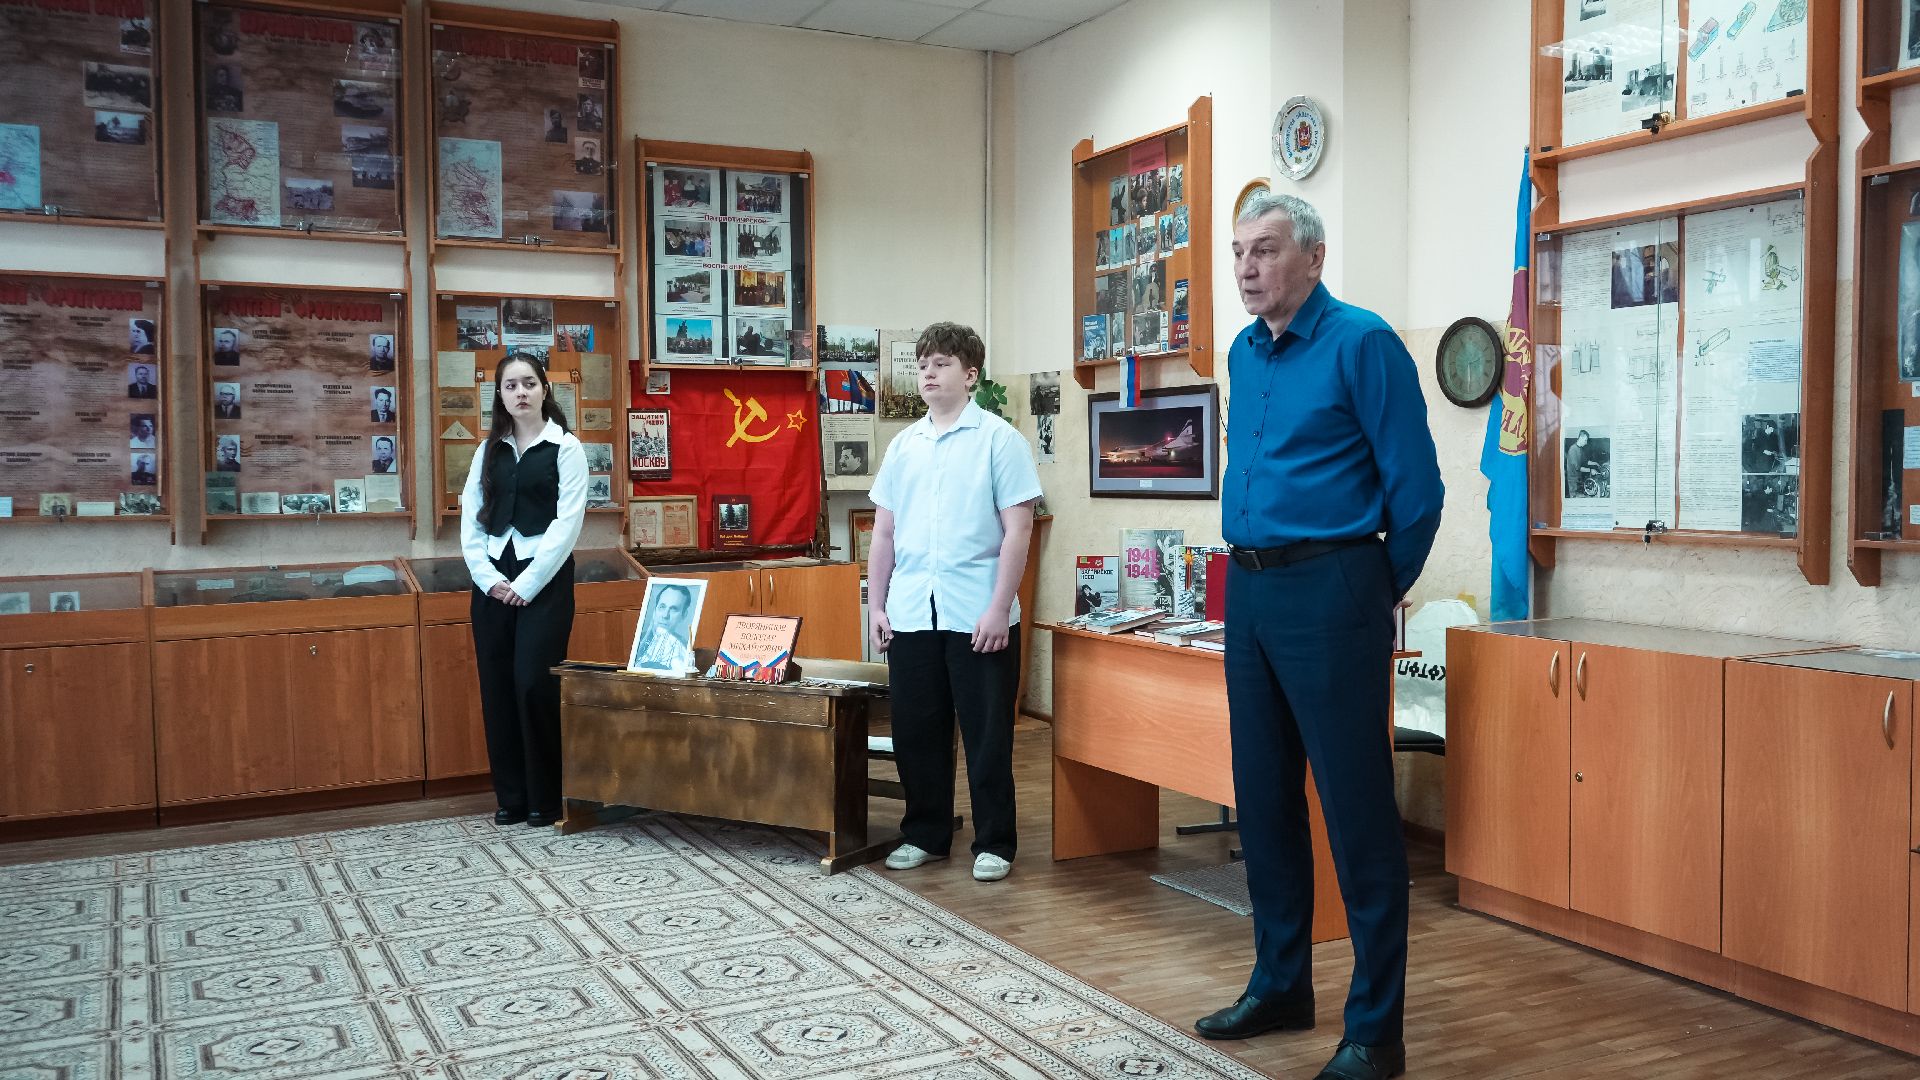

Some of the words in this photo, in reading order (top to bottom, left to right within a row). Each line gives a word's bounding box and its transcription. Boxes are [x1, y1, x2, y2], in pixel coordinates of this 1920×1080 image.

[704, 214, 768, 223] Патриотическое
[702, 262, 748, 271] воспитание
[632, 456, 667, 467] МОСКВУ
[1126, 548, 1157, 563] 1941
[1125, 564, 1161, 579] 1945
